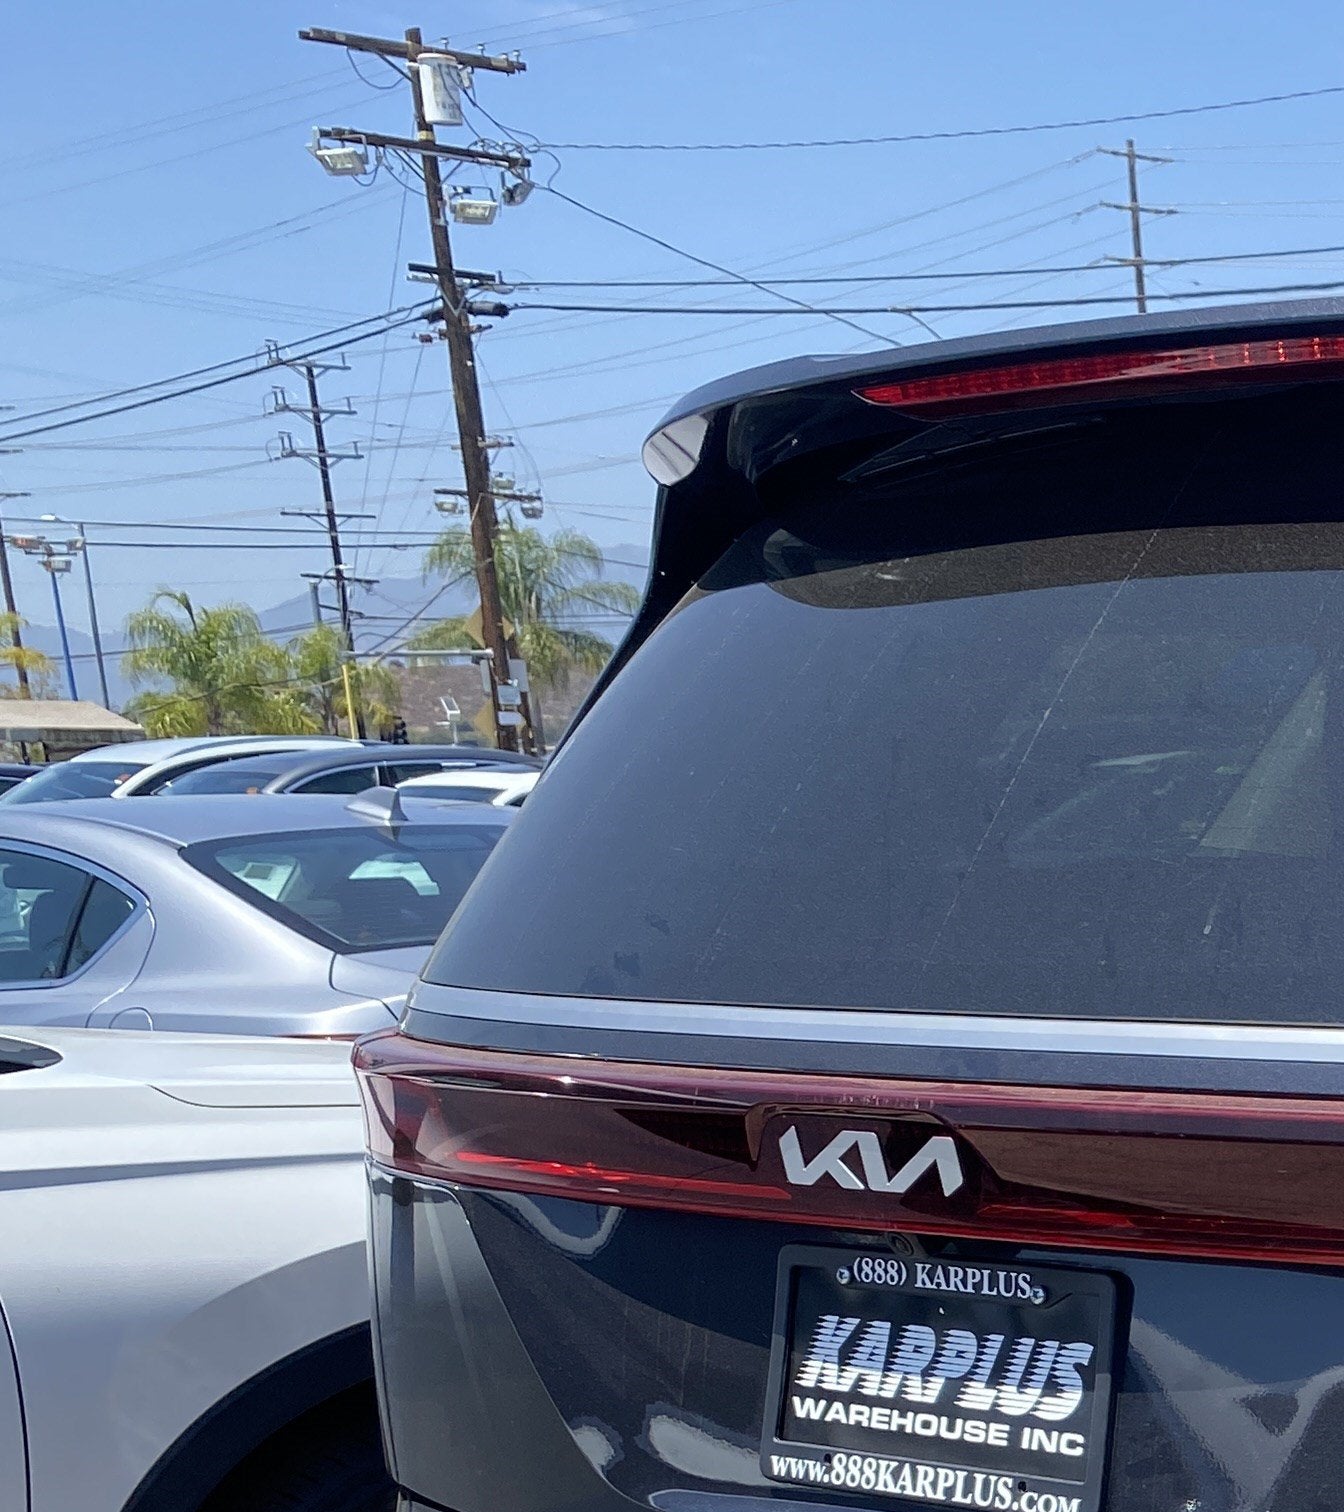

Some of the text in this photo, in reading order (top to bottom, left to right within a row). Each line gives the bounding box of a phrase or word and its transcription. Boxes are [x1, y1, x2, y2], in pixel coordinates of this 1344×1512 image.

[852, 1256, 1032, 1299] (888) KARPLUS
[794, 1314, 1094, 1421] KARPLUS
[791, 1395, 1085, 1456] WAREHOUSE INC
